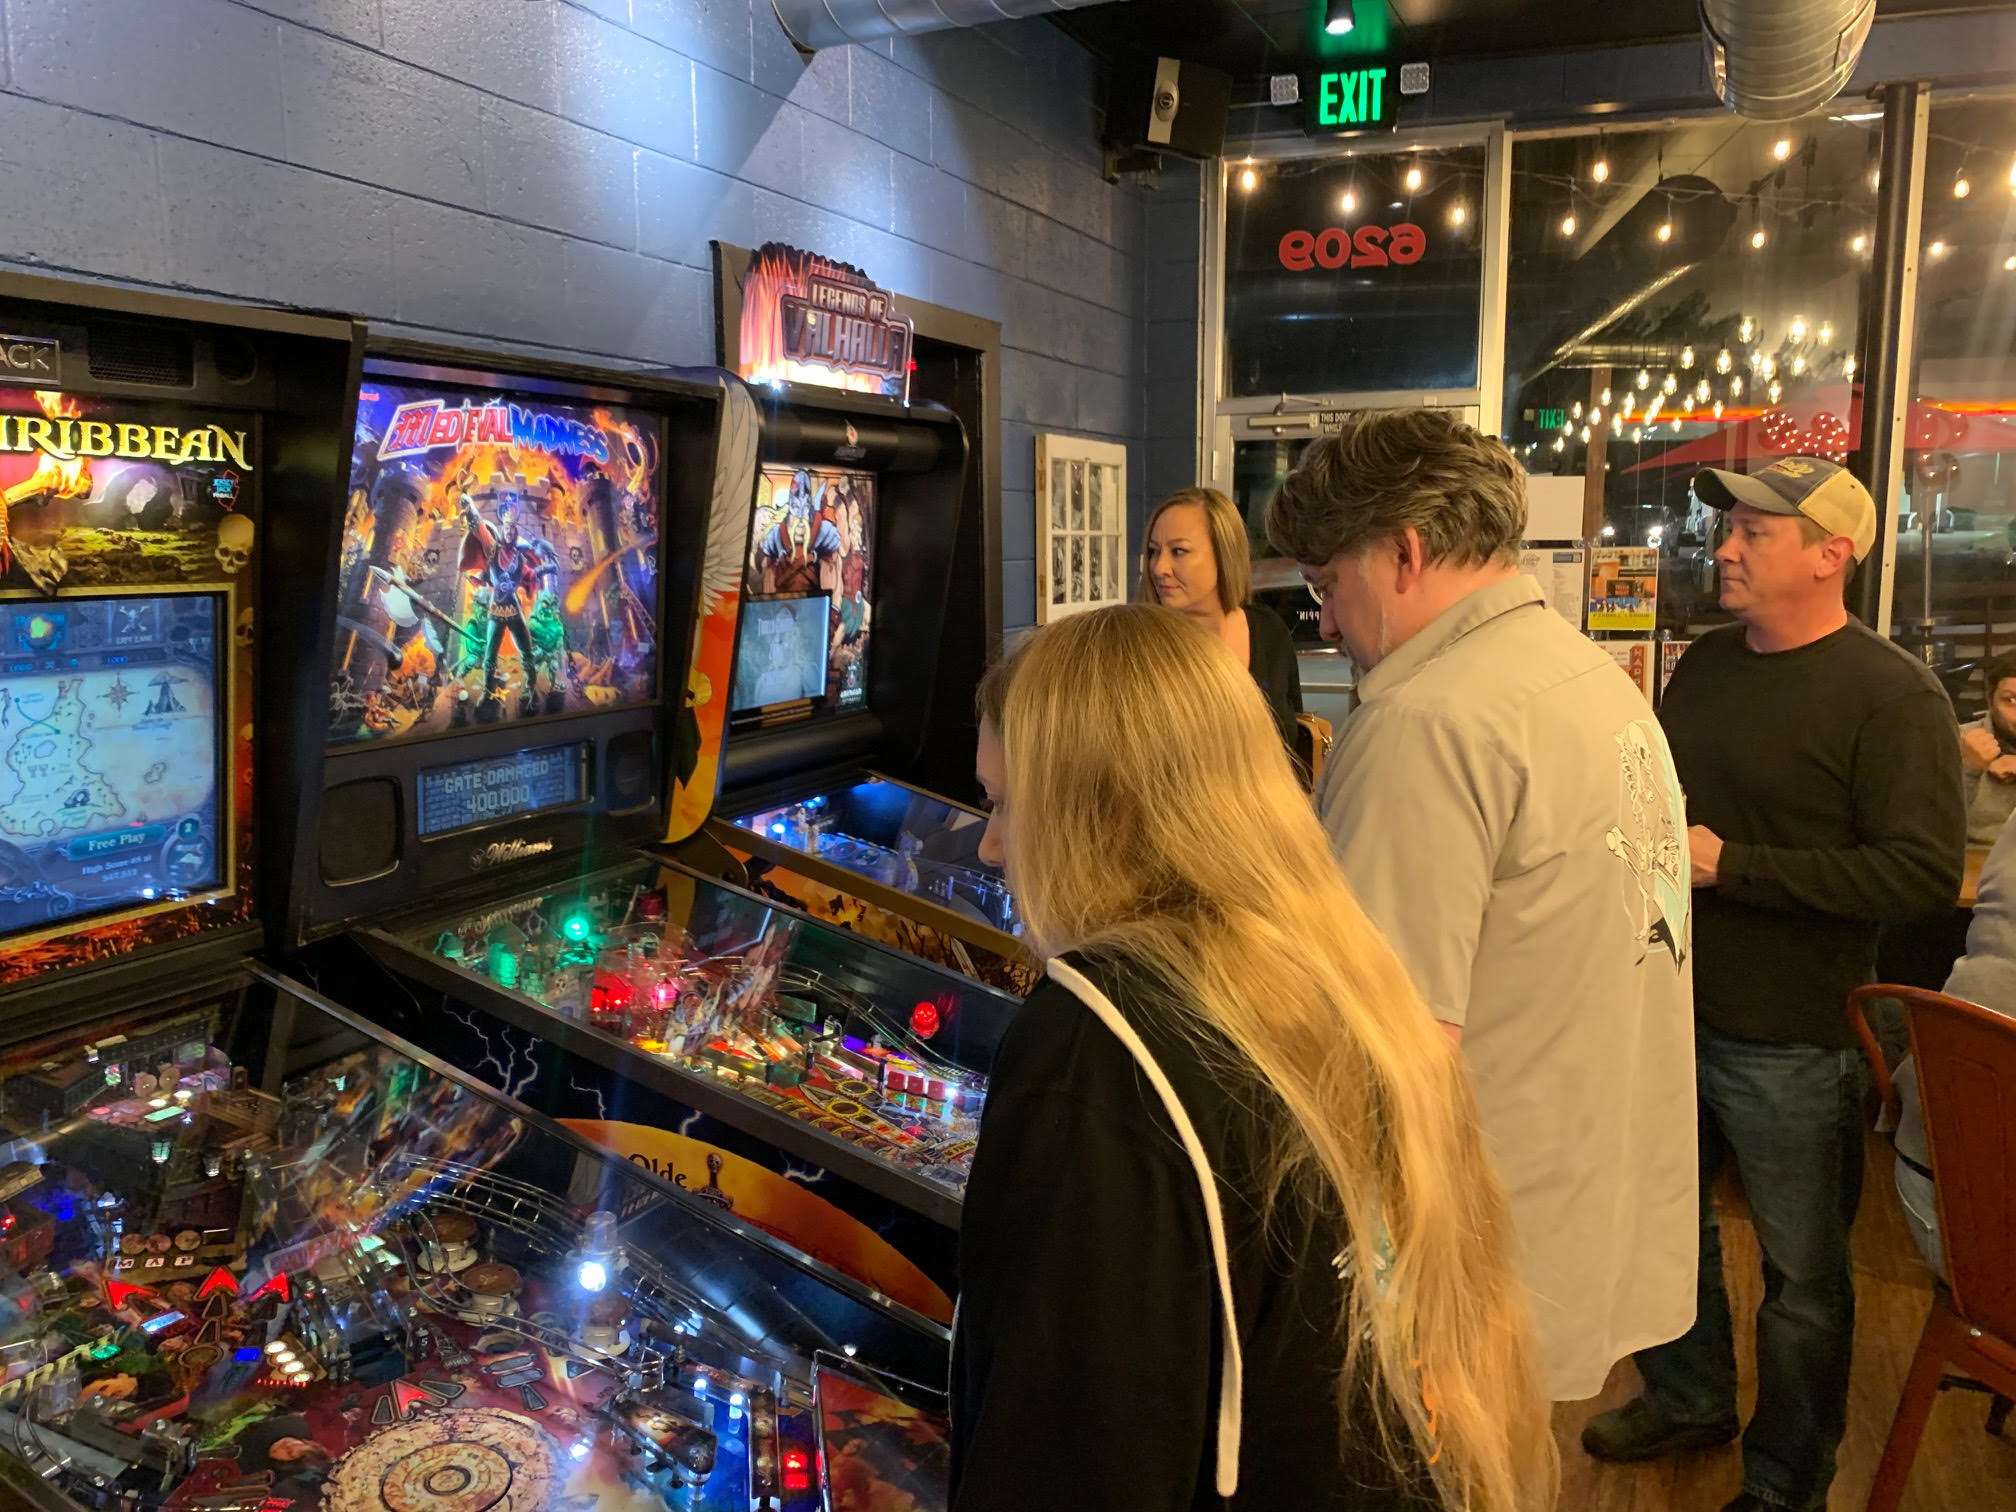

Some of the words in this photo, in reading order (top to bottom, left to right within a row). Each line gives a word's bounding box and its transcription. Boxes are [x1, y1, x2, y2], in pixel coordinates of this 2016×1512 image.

[1319, 68, 1387, 125] EXIT
[812, 284, 866, 317] LEGENDS
[869, 298, 884, 320] OF
[785, 304, 905, 371] VALHALLA
[389, 400, 514, 455] MEDIEVAL
[512, 405, 610, 463] MADNESS
[1321, 413, 1334, 423] THIS
[445, 772, 482, 794] GATE
[487, 760, 549, 783] DAMAGED
[88, 836, 116, 852] Free
[120, 831, 146, 846] Play
[487, 836, 554, 866] Williams
[628, 1153, 687, 1188] Olde
